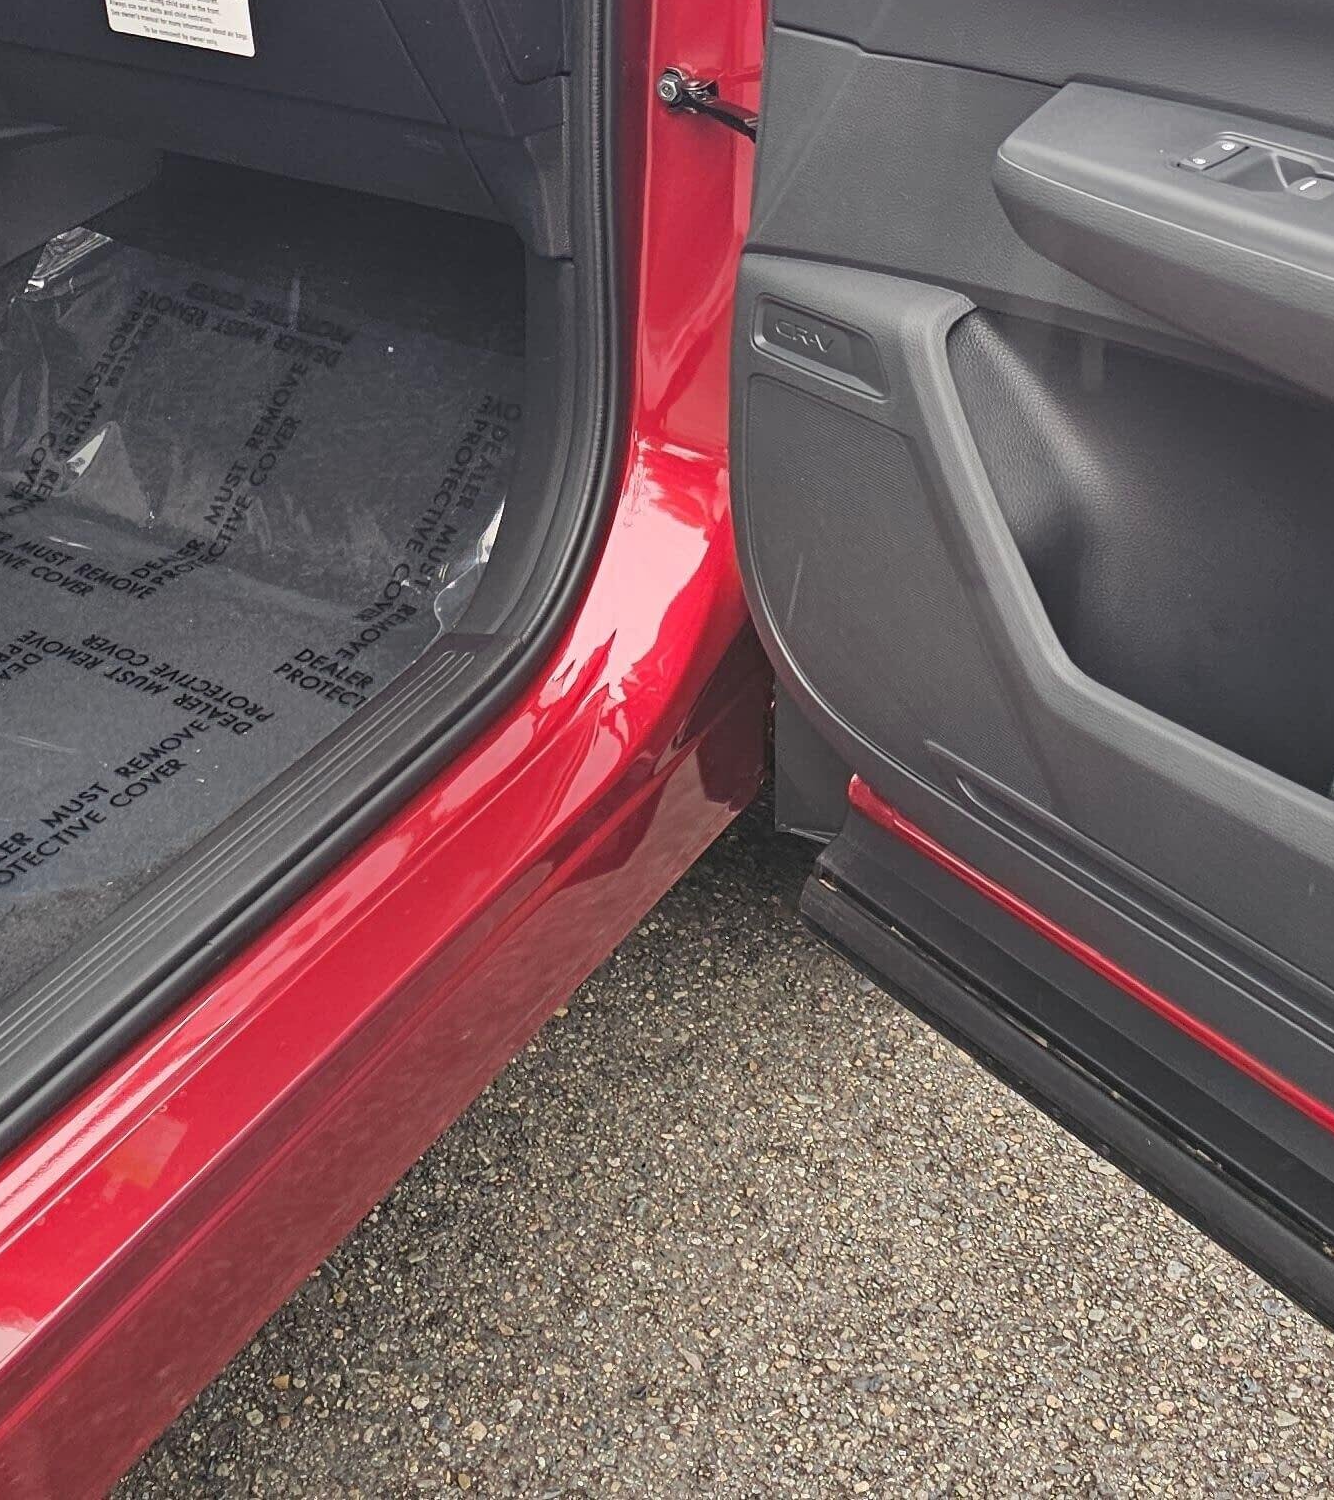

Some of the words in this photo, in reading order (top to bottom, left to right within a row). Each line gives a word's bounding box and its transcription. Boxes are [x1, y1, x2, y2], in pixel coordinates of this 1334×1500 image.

[774, 317, 835, 354] CR-V
[52, 310, 143, 428] PROTECTIVE
[129, 538, 207, 580] DEALER
[204, 459, 249, 527] MUST
[244, 361, 309, 451] REMOVE
[405, 417, 490, 551] PROTECTIVE
[455, 424, 510, 511] DEALER
[149, 493, 253, 588] PROTECTIVE
[249, 415, 303, 488] COVER
[16, 540, 75, 568] MUST
[73, 562, 157, 601] REMOVE
[29, 565, 96, 598] COVER
[413, 523, 458, 591] MUST
[354, 562, 411, 622] COVER
[15, 629, 104, 671] REMOVE
[80, 633, 150, 668] COVER
[335, 602, 418, 662] REMOVE
[103, 666, 170, 697] MUST
[148, 661, 276, 724] PROTECTIVE
[273, 661, 368, 709] PROTECT
[293, 647, 374, 690] DEALER
[172, 692, 255, 737] DEALER
[39, 780, 110, 830] MUST
[113, 718, 211, 780] REMOVE
[108, 757, 189, 809] COVER
